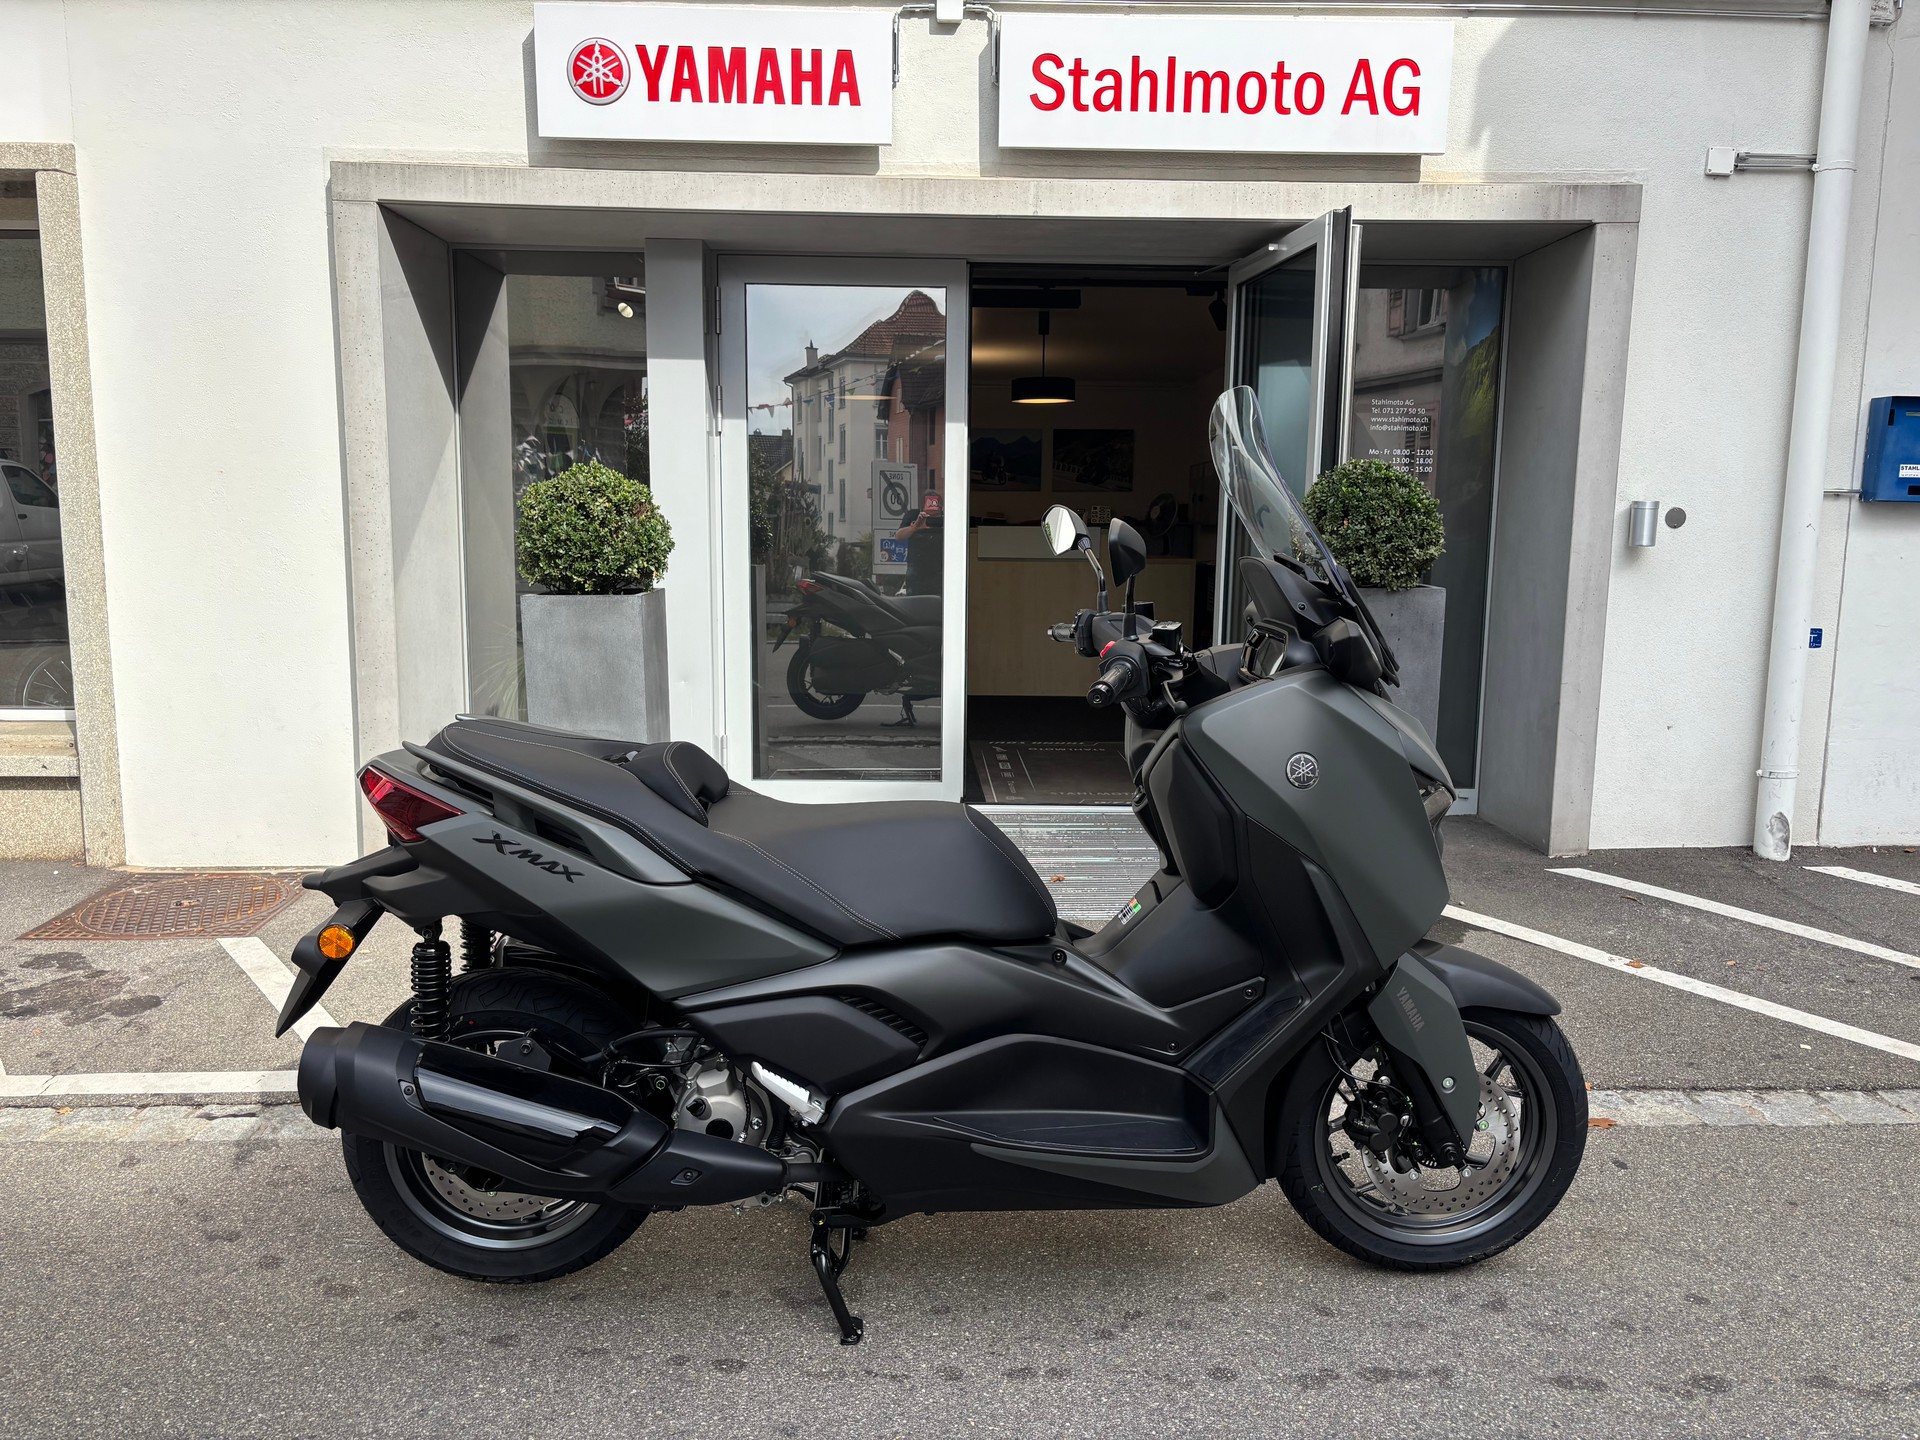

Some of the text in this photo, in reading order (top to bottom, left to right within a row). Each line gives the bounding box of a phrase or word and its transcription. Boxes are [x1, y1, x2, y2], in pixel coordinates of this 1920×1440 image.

[635, 44, 861, 106] YAMAHA
[1029, 53, 1421, 117] Stahlmoto AG
[1371, 398, 1404, 406] Stahlmoto
[1397, 986, 1424, 1032] YAMAHA
